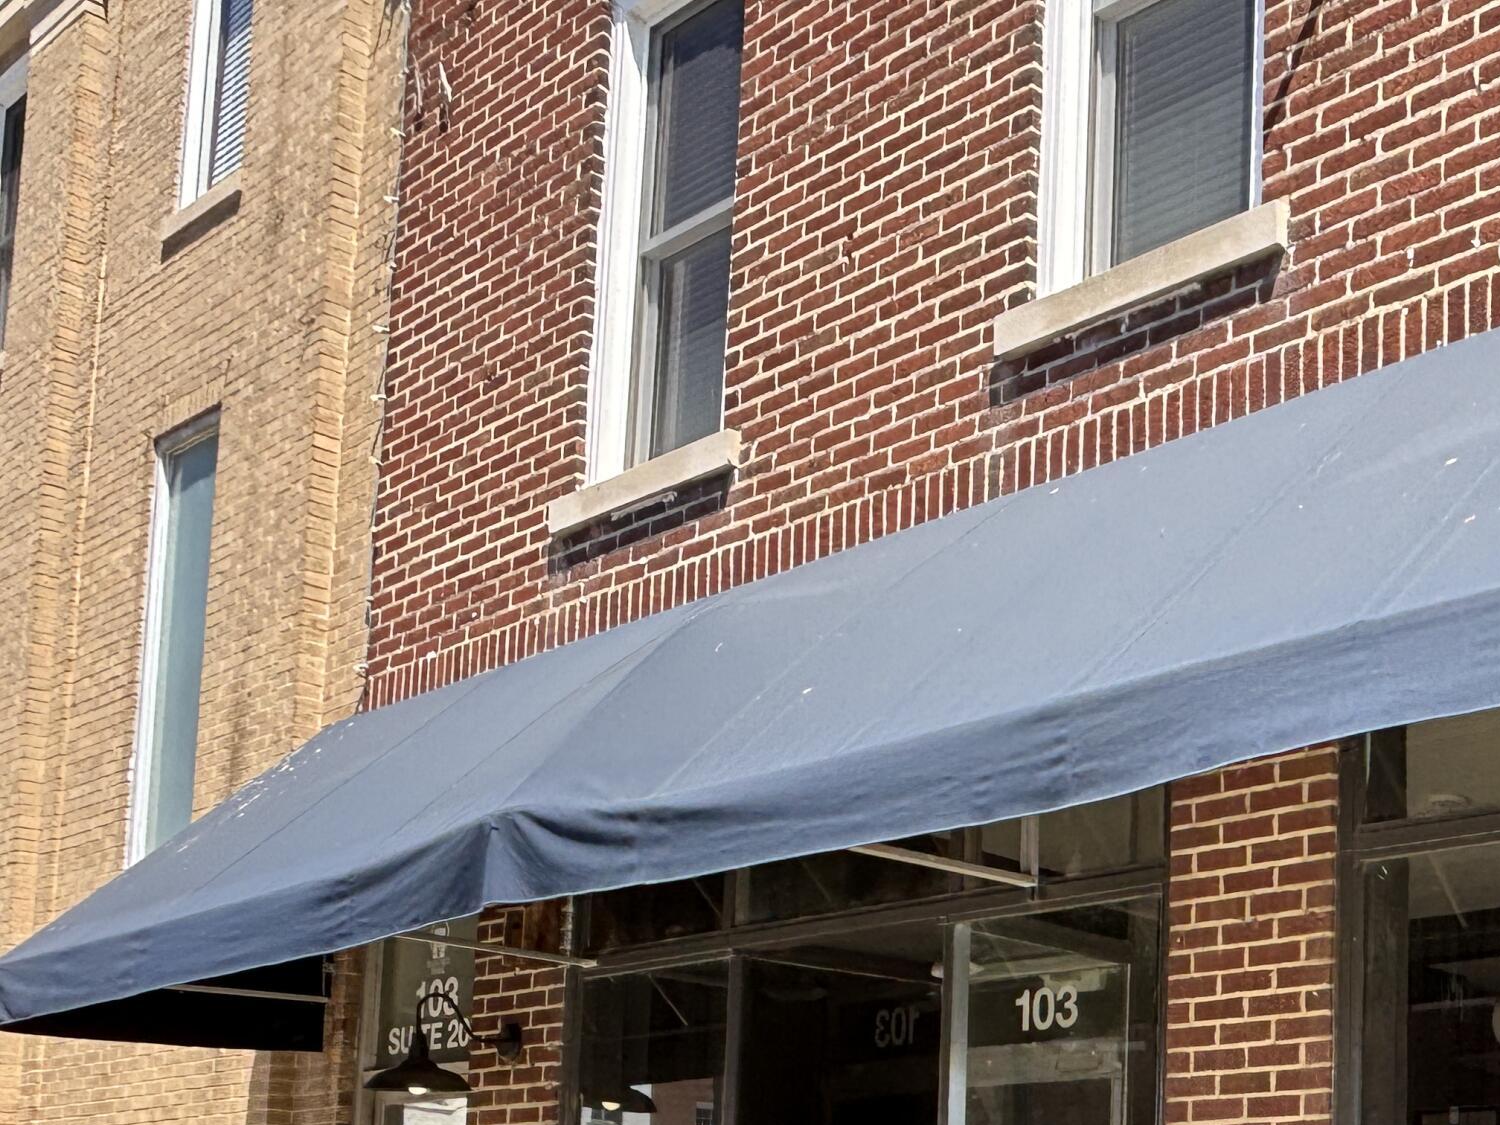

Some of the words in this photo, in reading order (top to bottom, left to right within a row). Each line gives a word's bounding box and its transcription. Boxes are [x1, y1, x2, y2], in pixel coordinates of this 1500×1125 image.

[416, 976, 459, 1019] 103
[1015, 986, 1079, 1032] 103
[388, 1021, 444, 1056] SUTE
